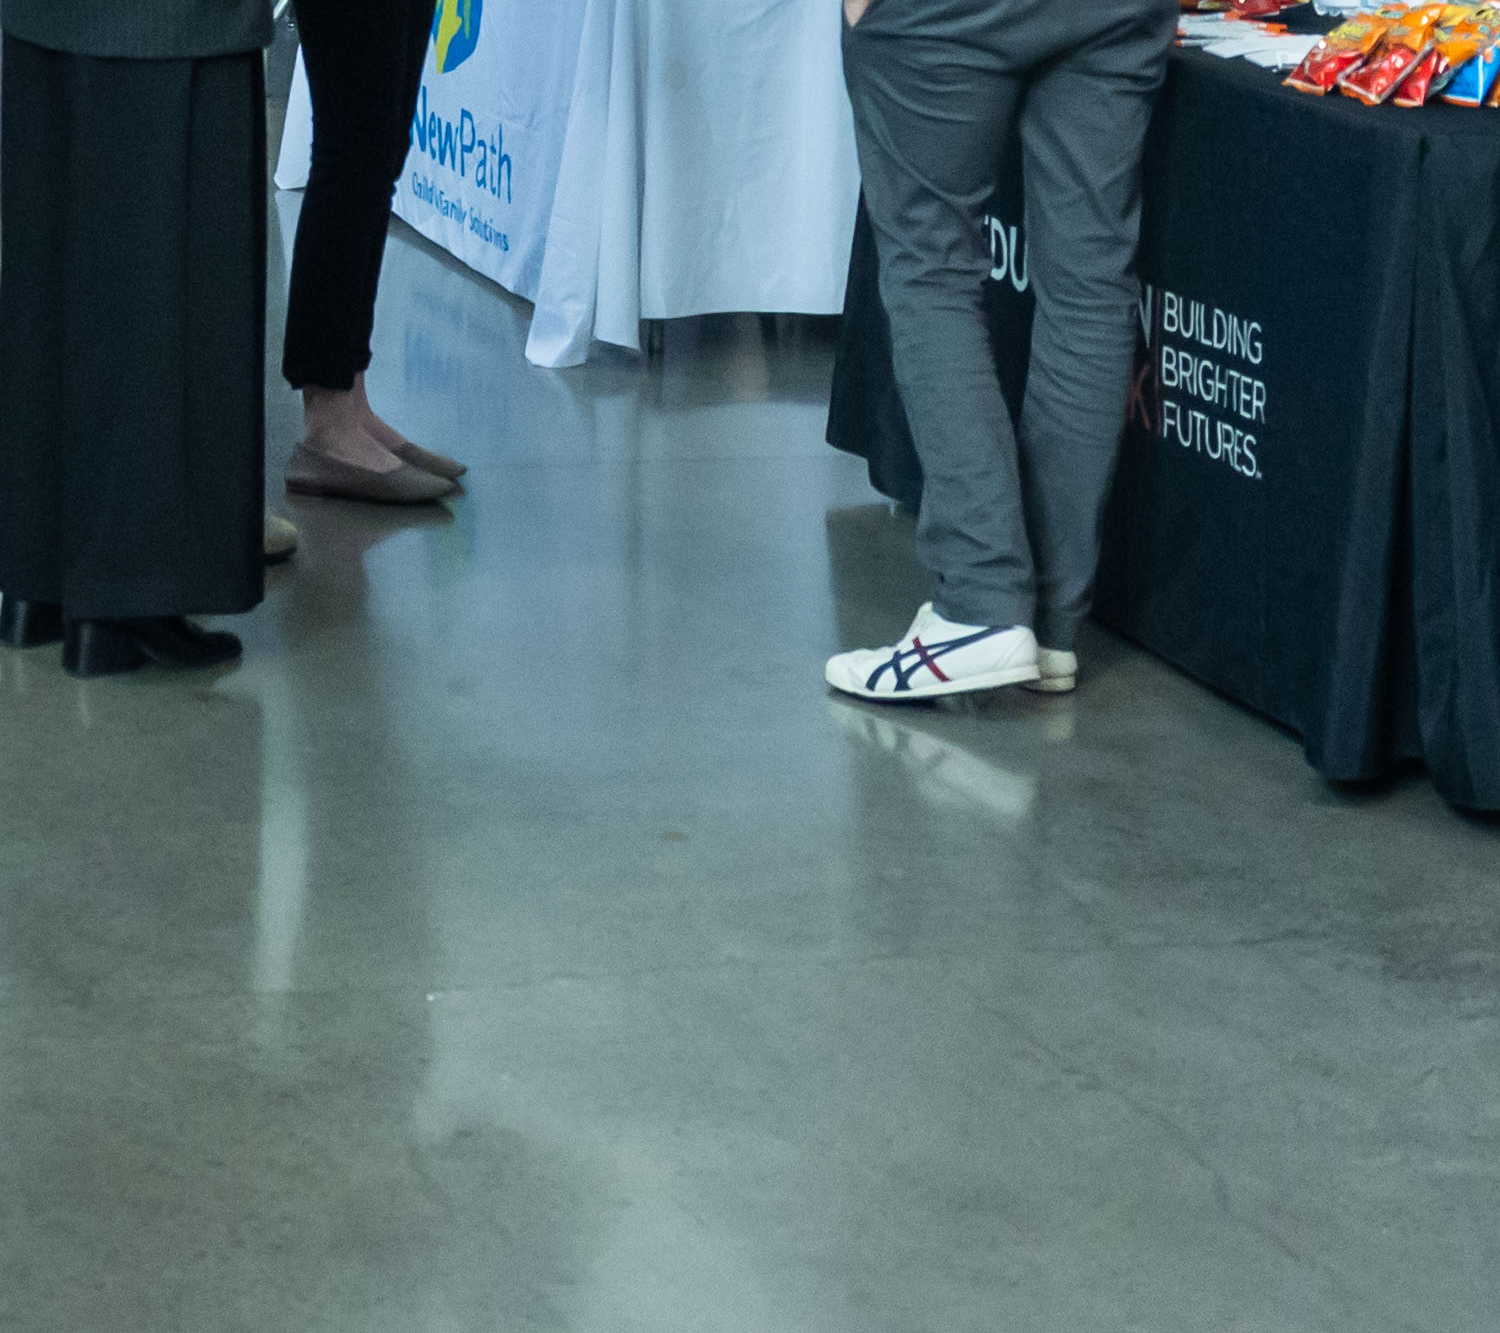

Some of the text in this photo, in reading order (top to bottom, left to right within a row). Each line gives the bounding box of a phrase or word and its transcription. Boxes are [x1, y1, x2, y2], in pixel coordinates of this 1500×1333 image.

[408, 84, 512, 205] NewPath
[1163, 290, 1263, 364] BUILDING
[1162, 346, 1267, 425] BRIGHTER
